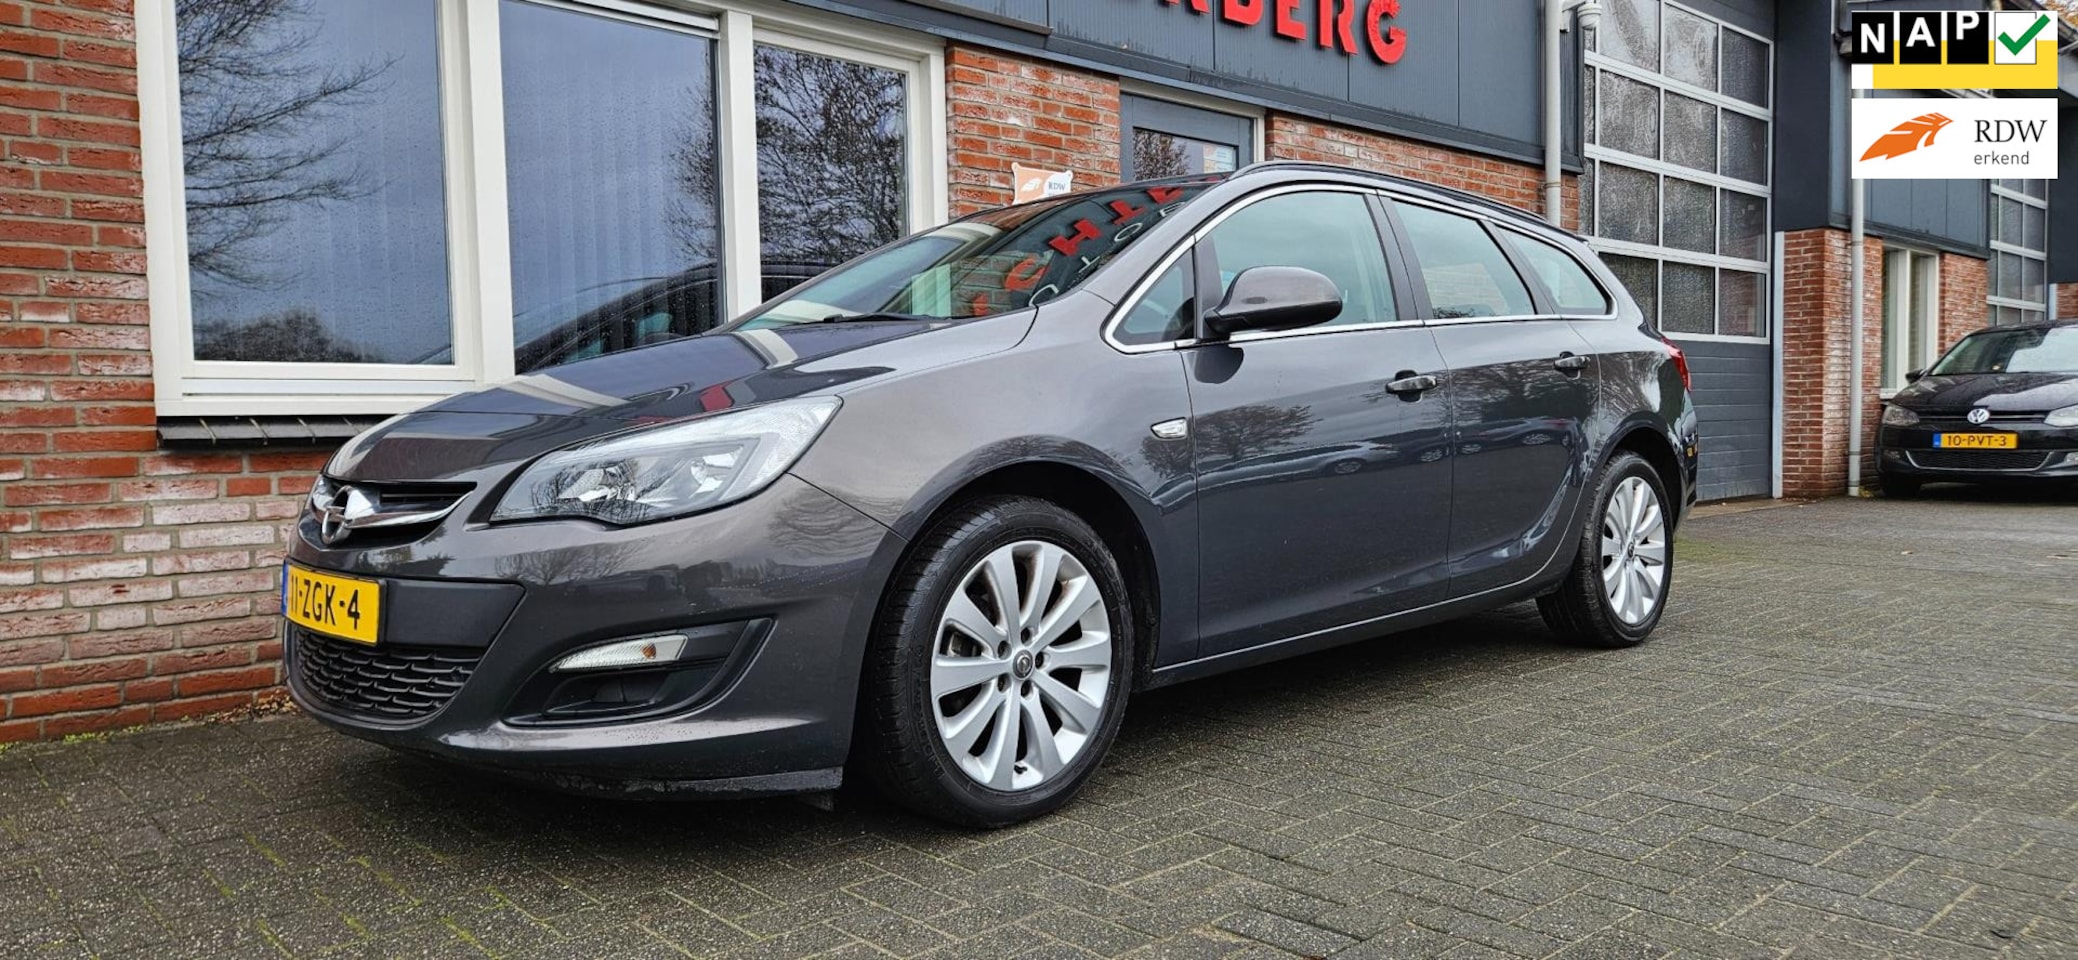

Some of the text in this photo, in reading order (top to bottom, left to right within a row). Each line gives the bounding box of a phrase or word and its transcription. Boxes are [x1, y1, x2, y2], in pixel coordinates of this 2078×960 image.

[1048, 181, 1066, 191] RDW
[1948, 434, 2007, 446] 10-PVT-3
[291, 575, 360, 630] 11-ZGK-4
